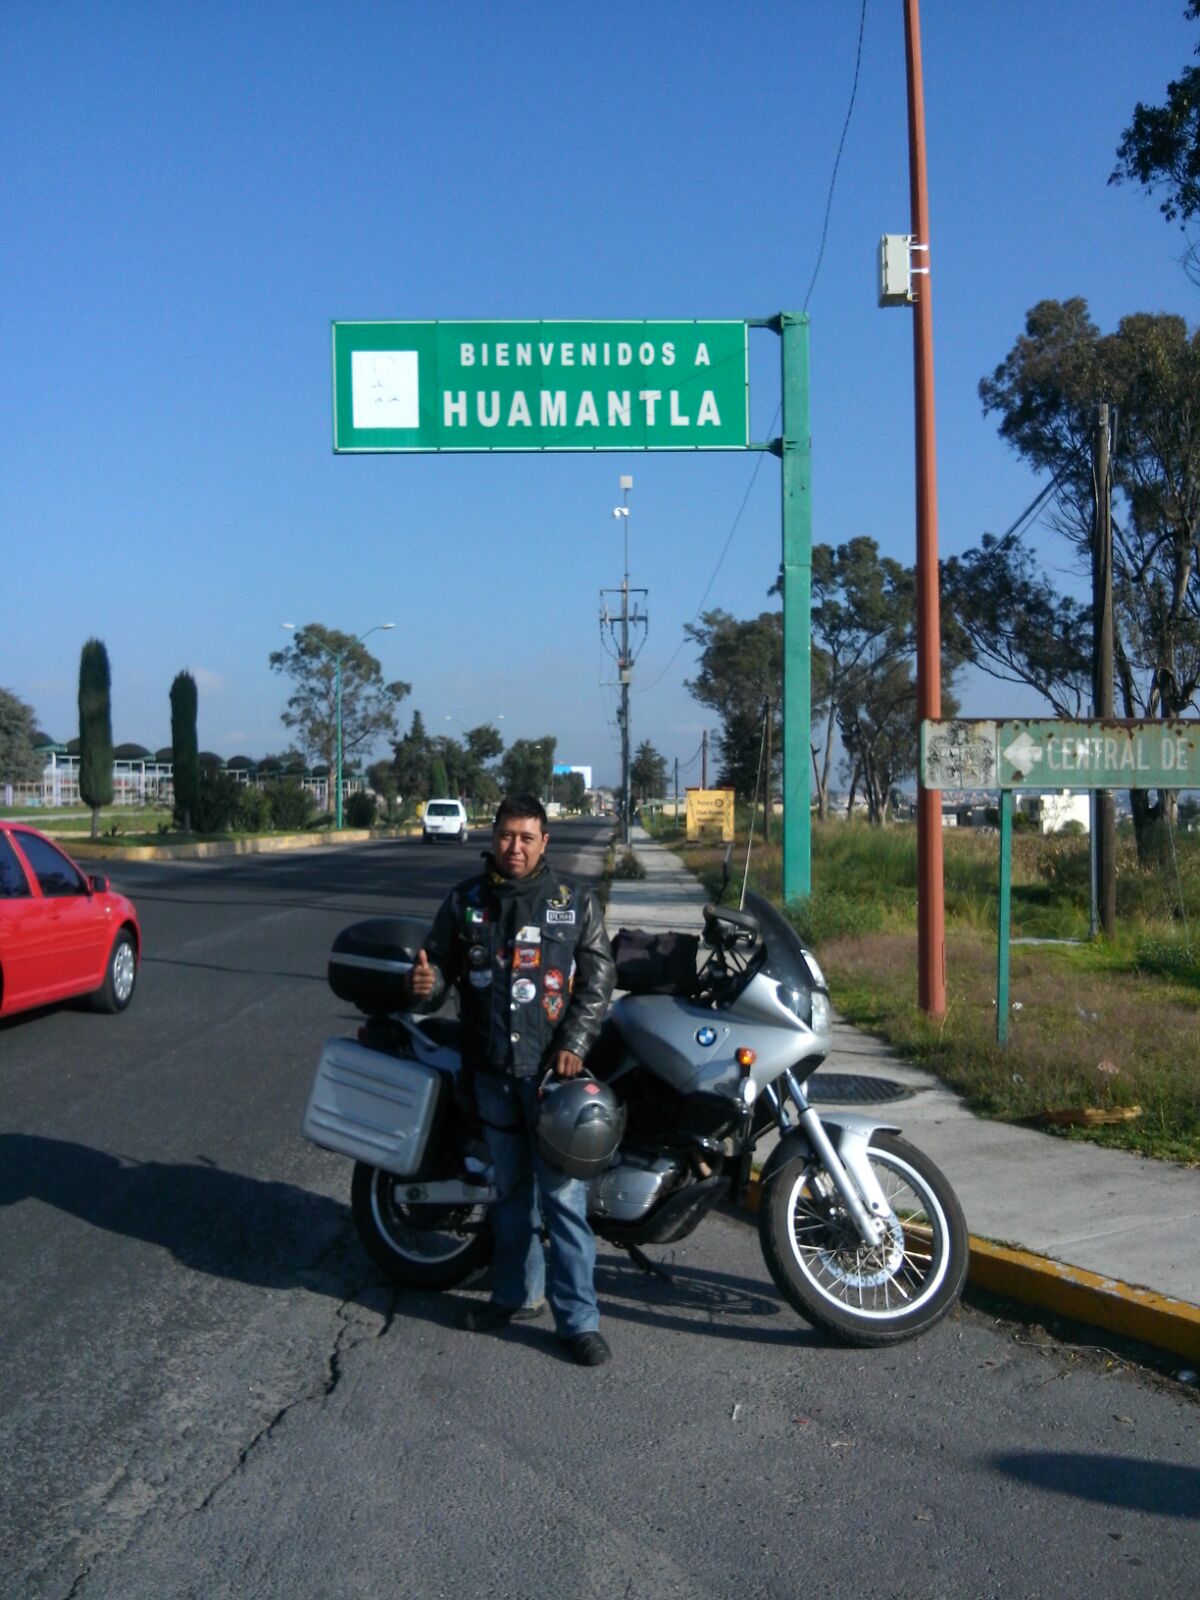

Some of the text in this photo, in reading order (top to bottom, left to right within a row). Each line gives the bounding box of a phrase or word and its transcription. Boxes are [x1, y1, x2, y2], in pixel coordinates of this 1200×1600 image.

[460, 343, 711, 366] BIENVENIDOS A
[443, 390, 721, 427] HUAMANTLA
[1047, 738, 1188, 770] CENTRAL DE
